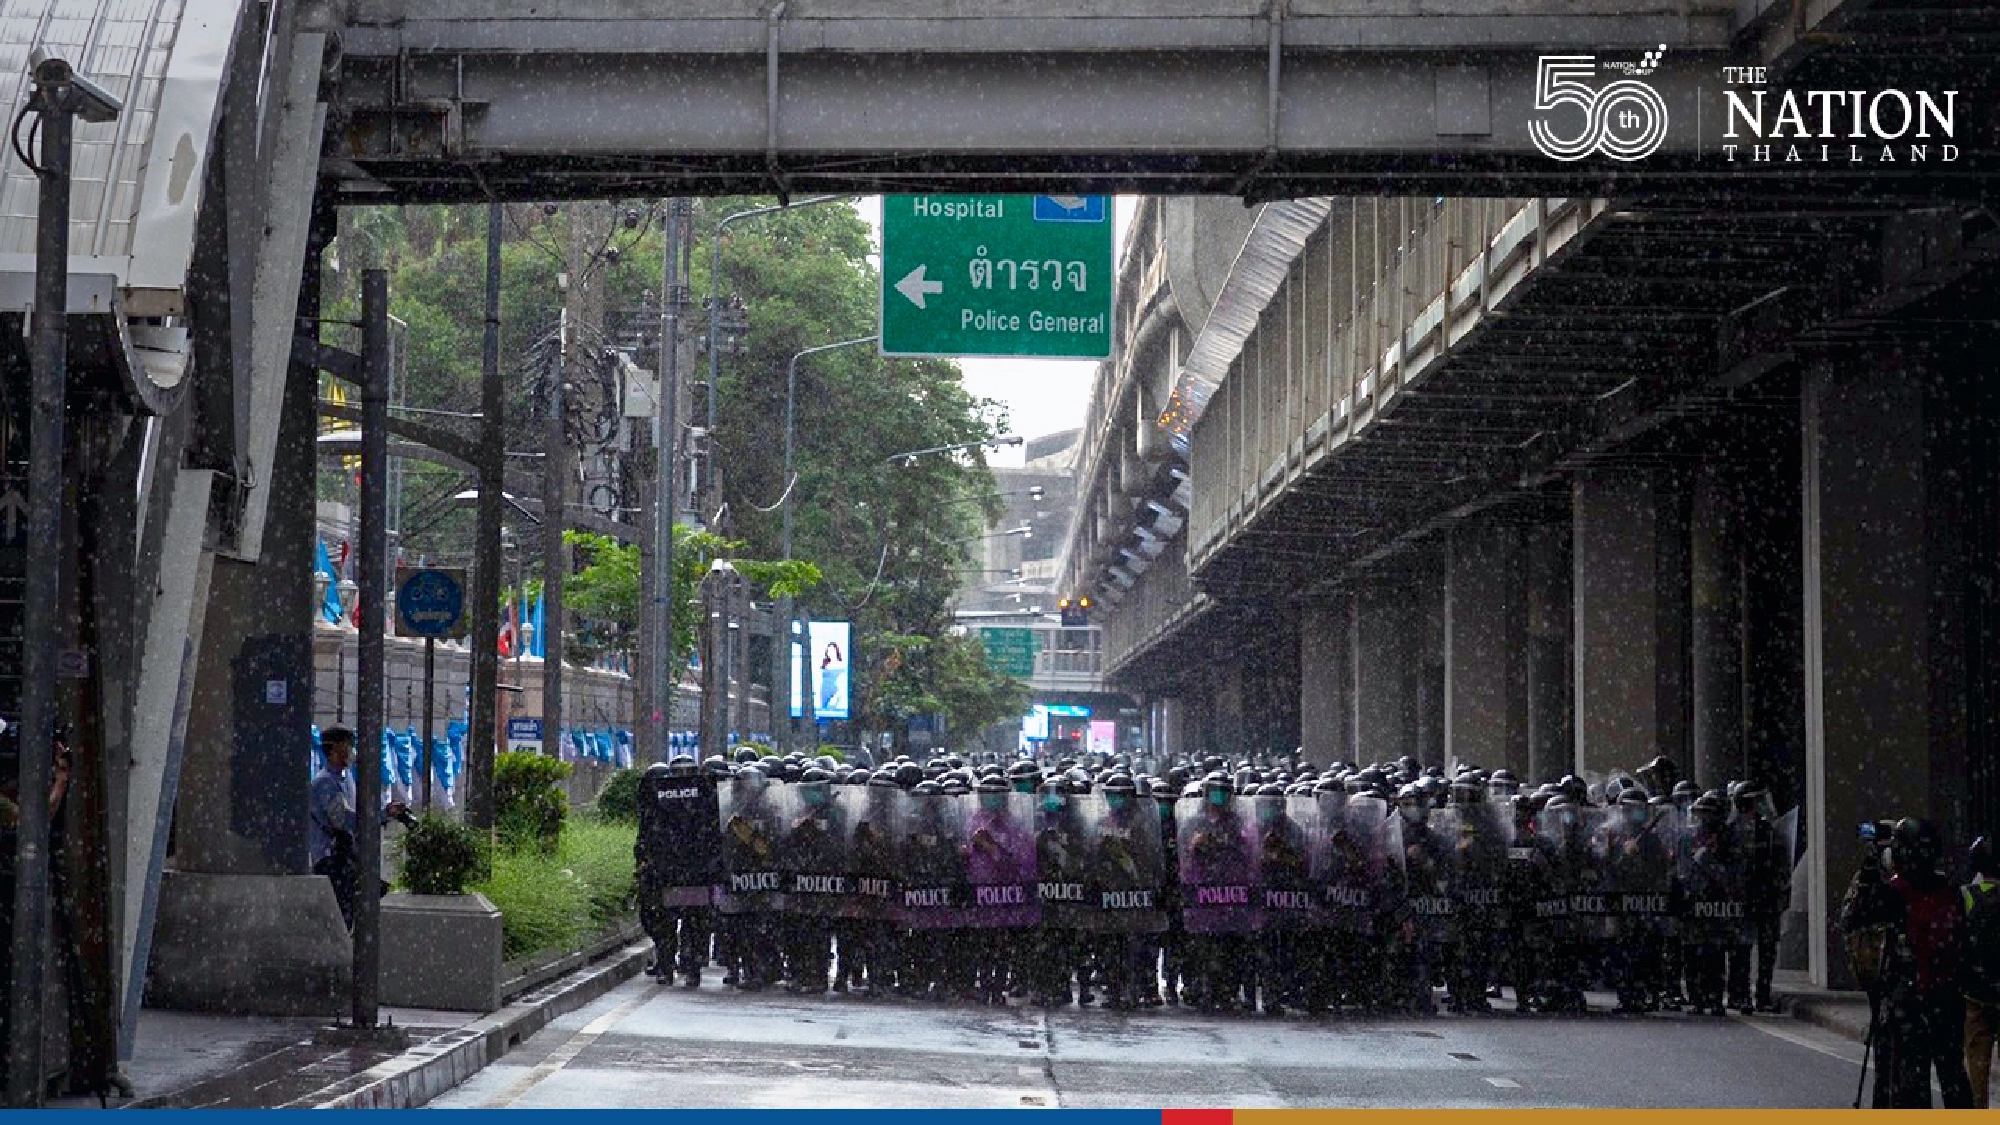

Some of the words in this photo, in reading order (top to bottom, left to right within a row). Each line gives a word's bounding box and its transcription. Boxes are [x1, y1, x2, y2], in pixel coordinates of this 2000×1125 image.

[913, 197, 1004, 221] Hospital
[968, 244, 1087, 293] ตำรวจ
[961, 308, 1021, 332] Police
[1029, 310, 1105, 334] General
[657, 786, 699, 799] POLICE
[731, 872, 780, 892] POLICE
[796, 873, 846, 893] POLICE
[1037, 882, 1084, 902] POLICE
[904, 887, 950, 907] POLICE
[976, 885, 1024, 905] POLICE
[1101, 889, 1152, 909] POLICE
[1198, 885, 1250, 904] POLICE
[1621, 893, 1668, 912] POLICE
[1694, 900, 1746, 918] POLICE
